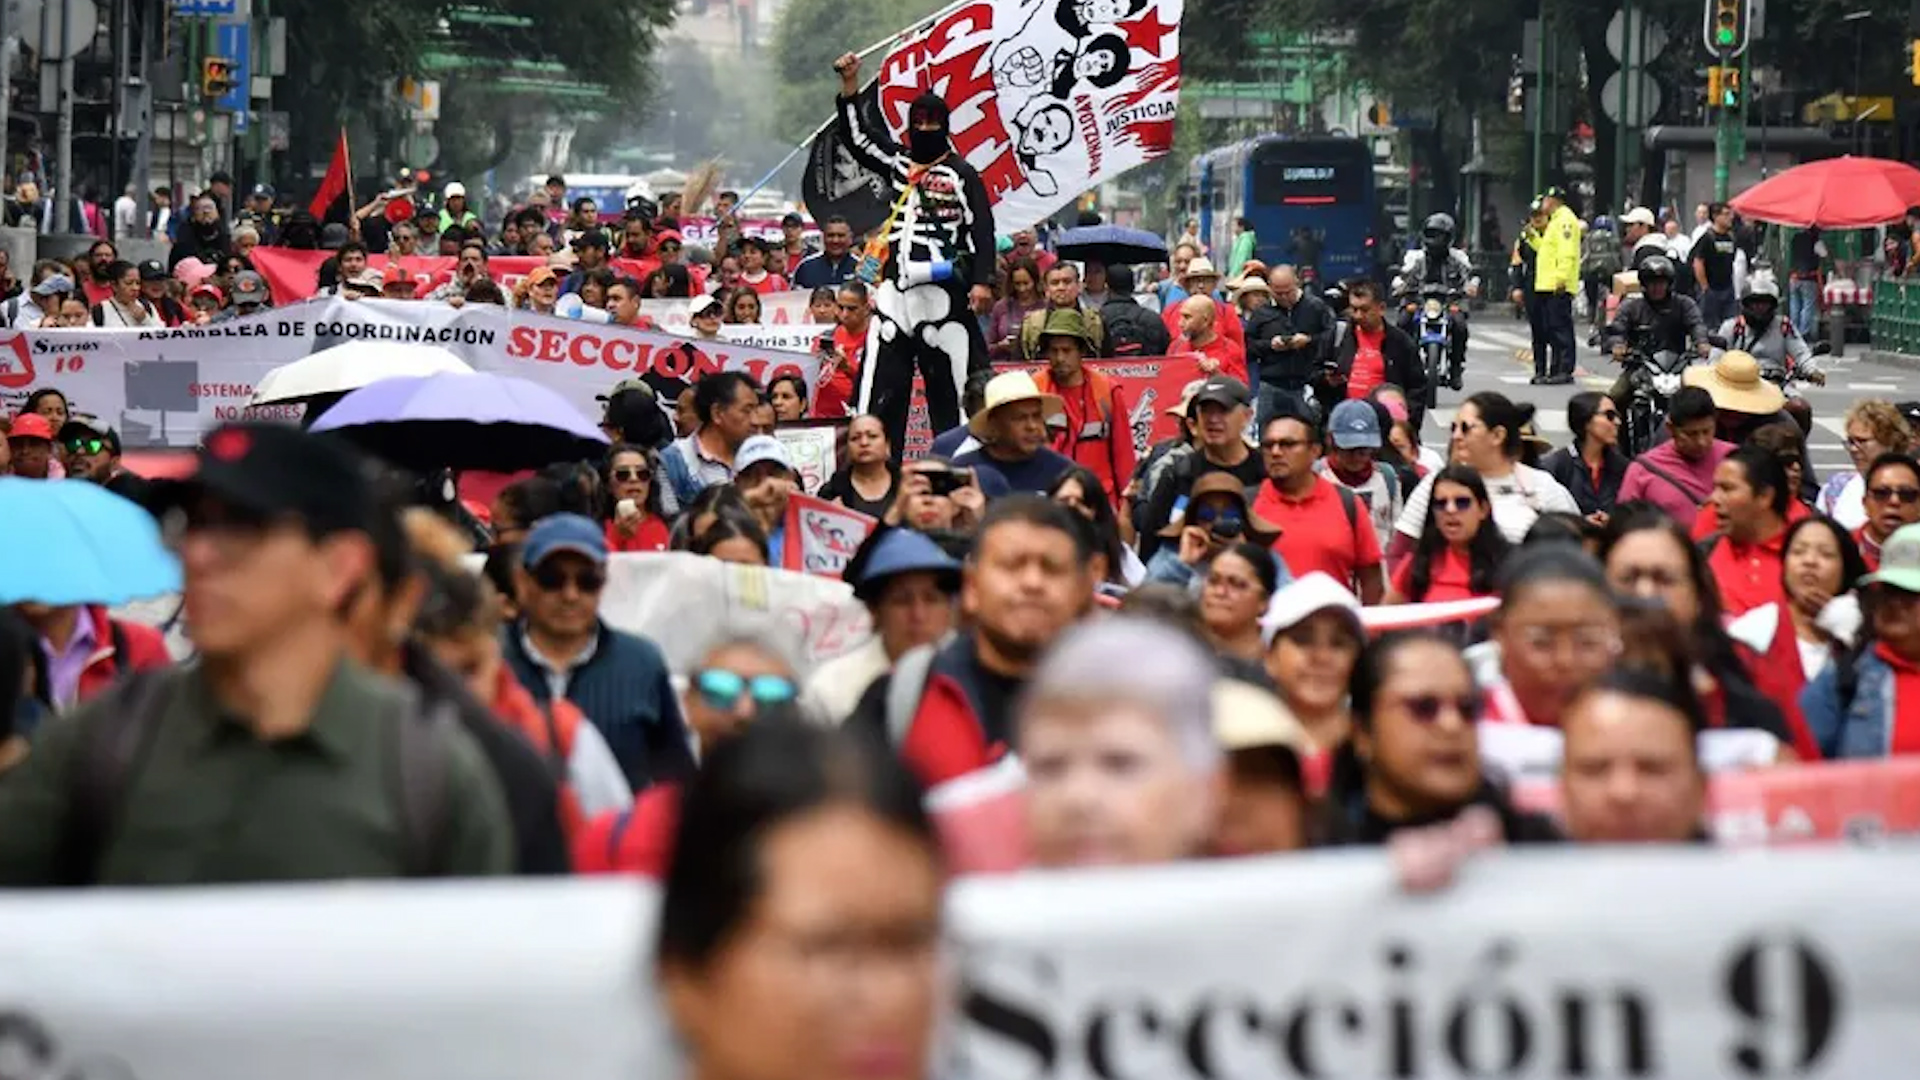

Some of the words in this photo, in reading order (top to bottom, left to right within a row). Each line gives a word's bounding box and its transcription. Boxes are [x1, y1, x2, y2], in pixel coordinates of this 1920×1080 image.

[924, 3, 1028, 206] CNTE
[1104, 101, 1175, 136] JUSTICIA
[1074, 94, 1103, 178] AYOTZINAPA
[139, 322, 268, 340] ASAMBLEA
[278, 322, 305, 336] DE
[315, 322, 495, 344] COORDINACIÓN
[55, 355, 84, 373] 10
[507, 326, 729, 386] SECCIÓN
[189, 384, 252, 397] SISTEMA
[215, 406, 237, 419] NO
[242, 406, 301, 420] AFORES
[957, 936, 1660, 1080] Sección
[1722, 928, 1842, 1078] 9
